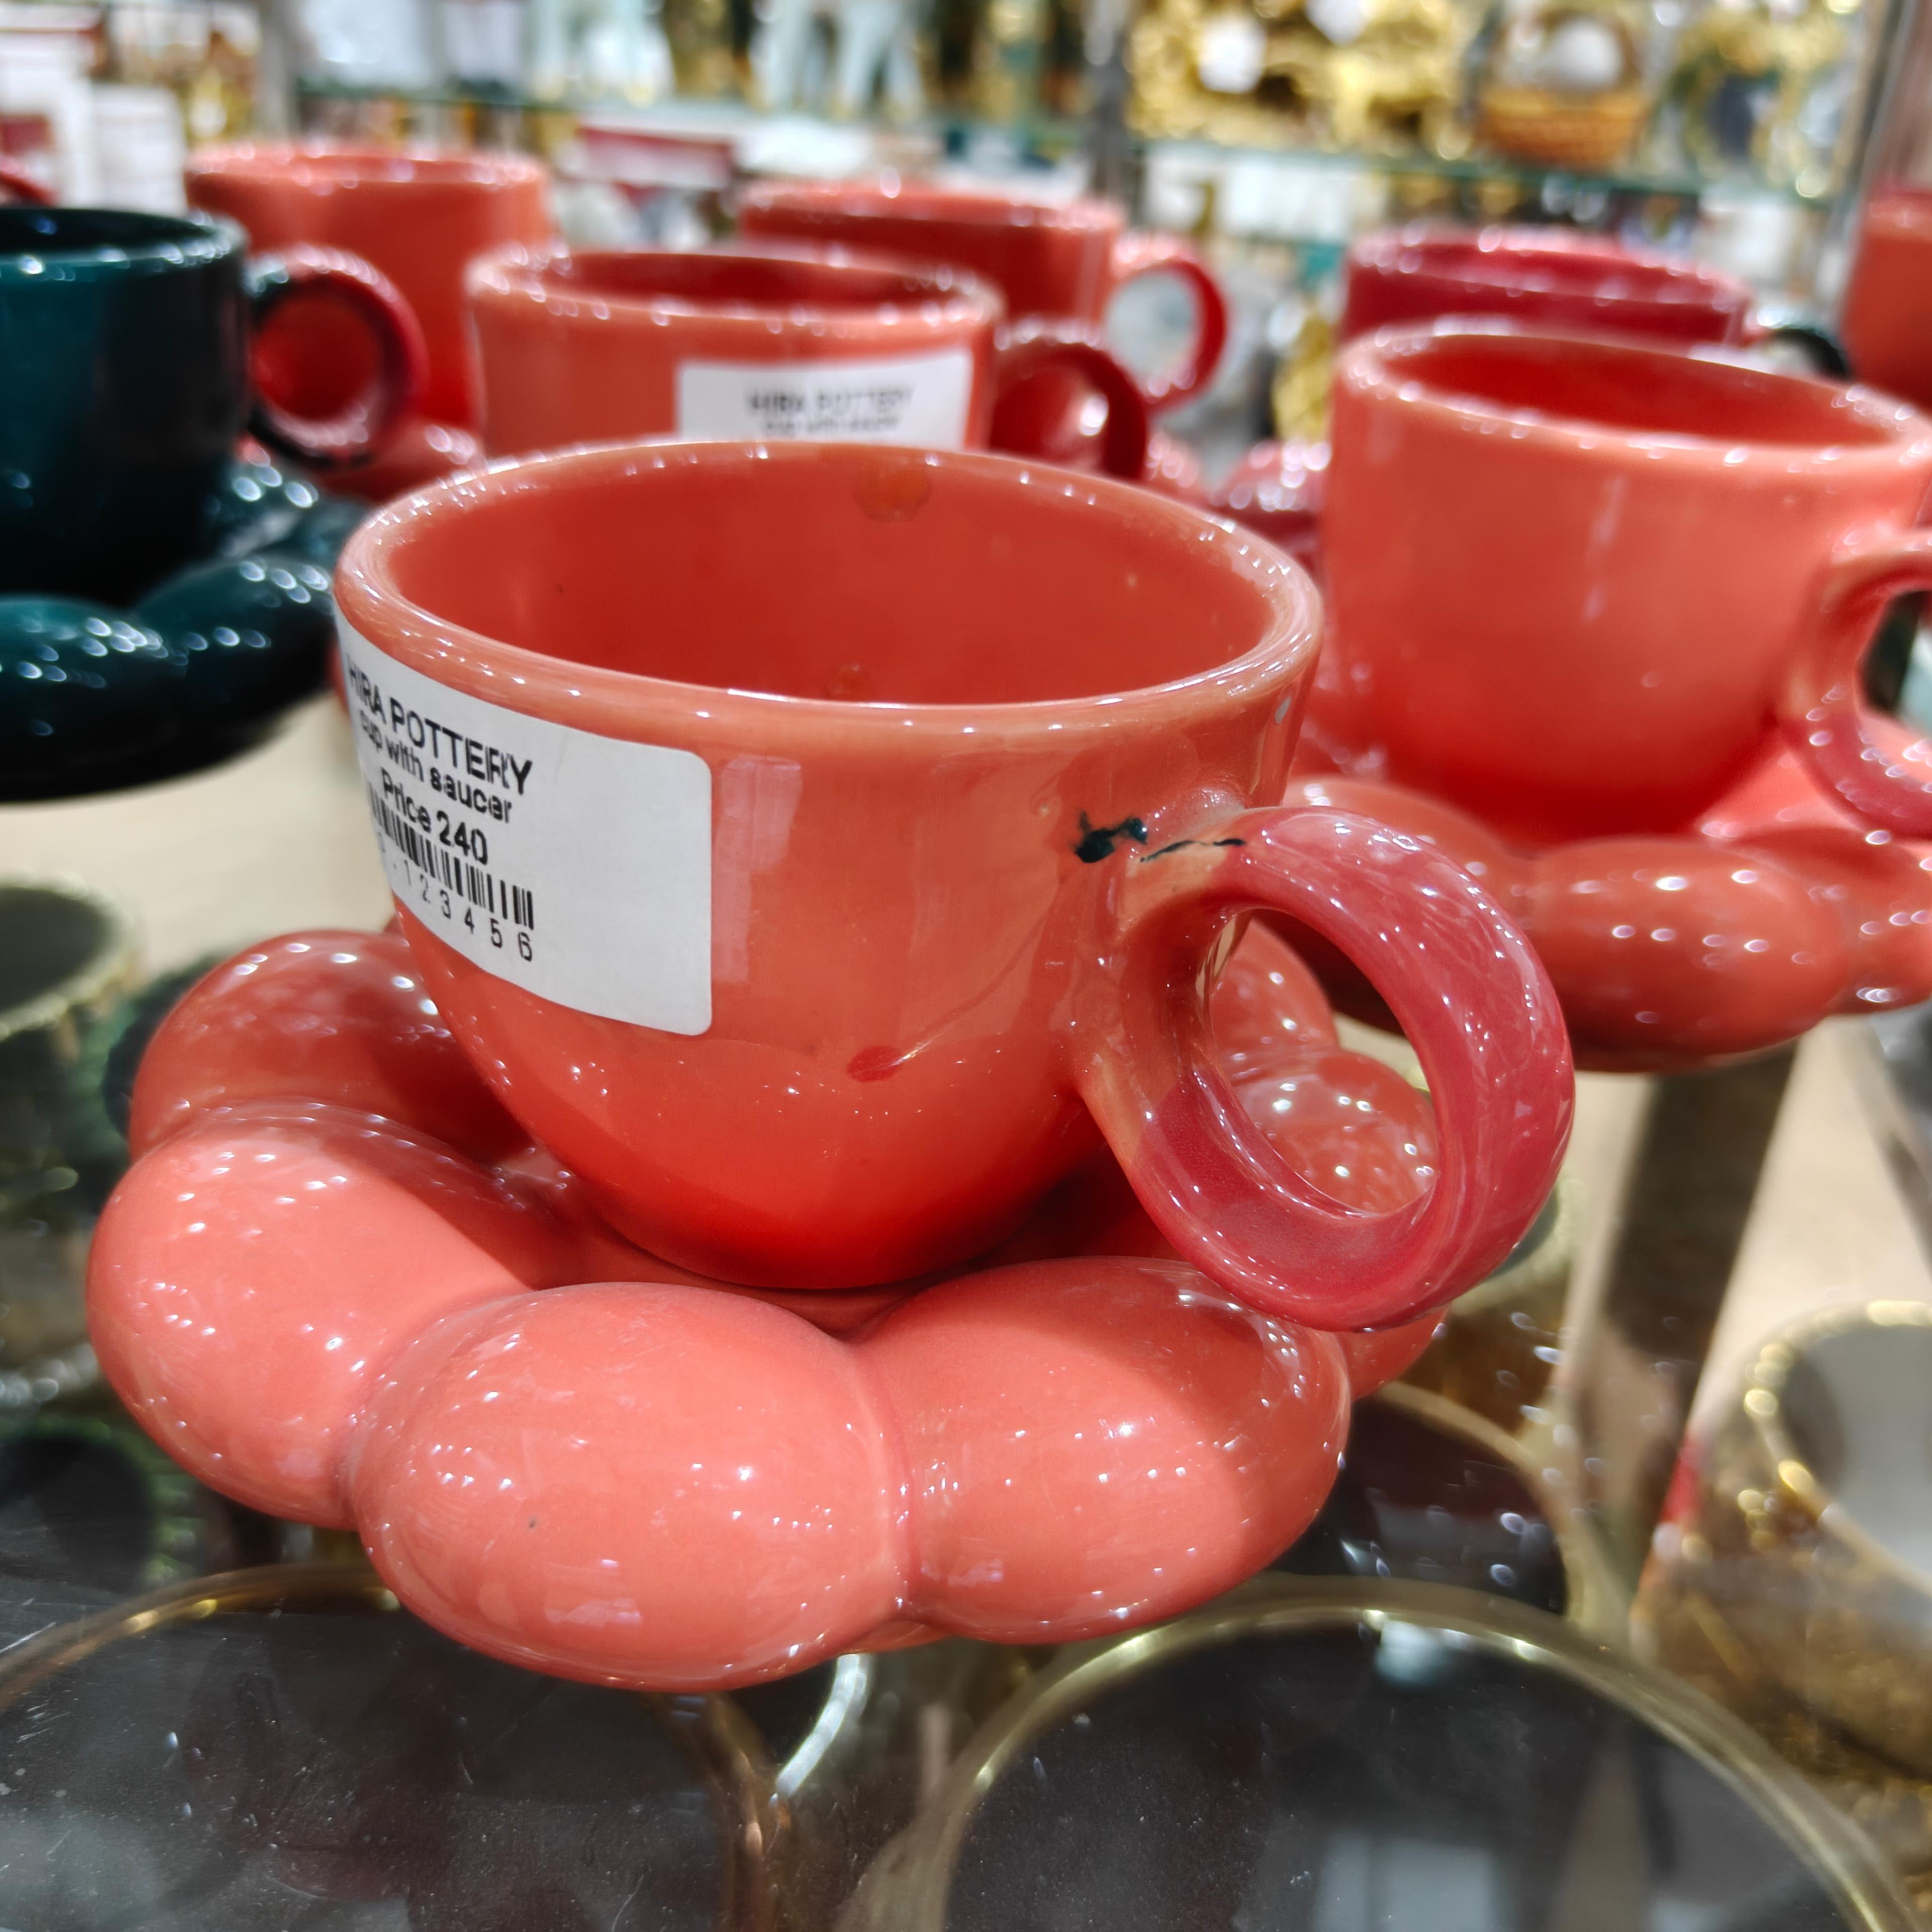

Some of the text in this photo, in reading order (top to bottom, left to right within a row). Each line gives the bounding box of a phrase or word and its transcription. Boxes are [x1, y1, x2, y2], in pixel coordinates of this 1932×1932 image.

[347, 653, 533, 795] HIRA POTTERY
[381, 767, 488, 865] Price 240
[385, 736, 424, 782] with
[430, 767, 512, 823] saucer
